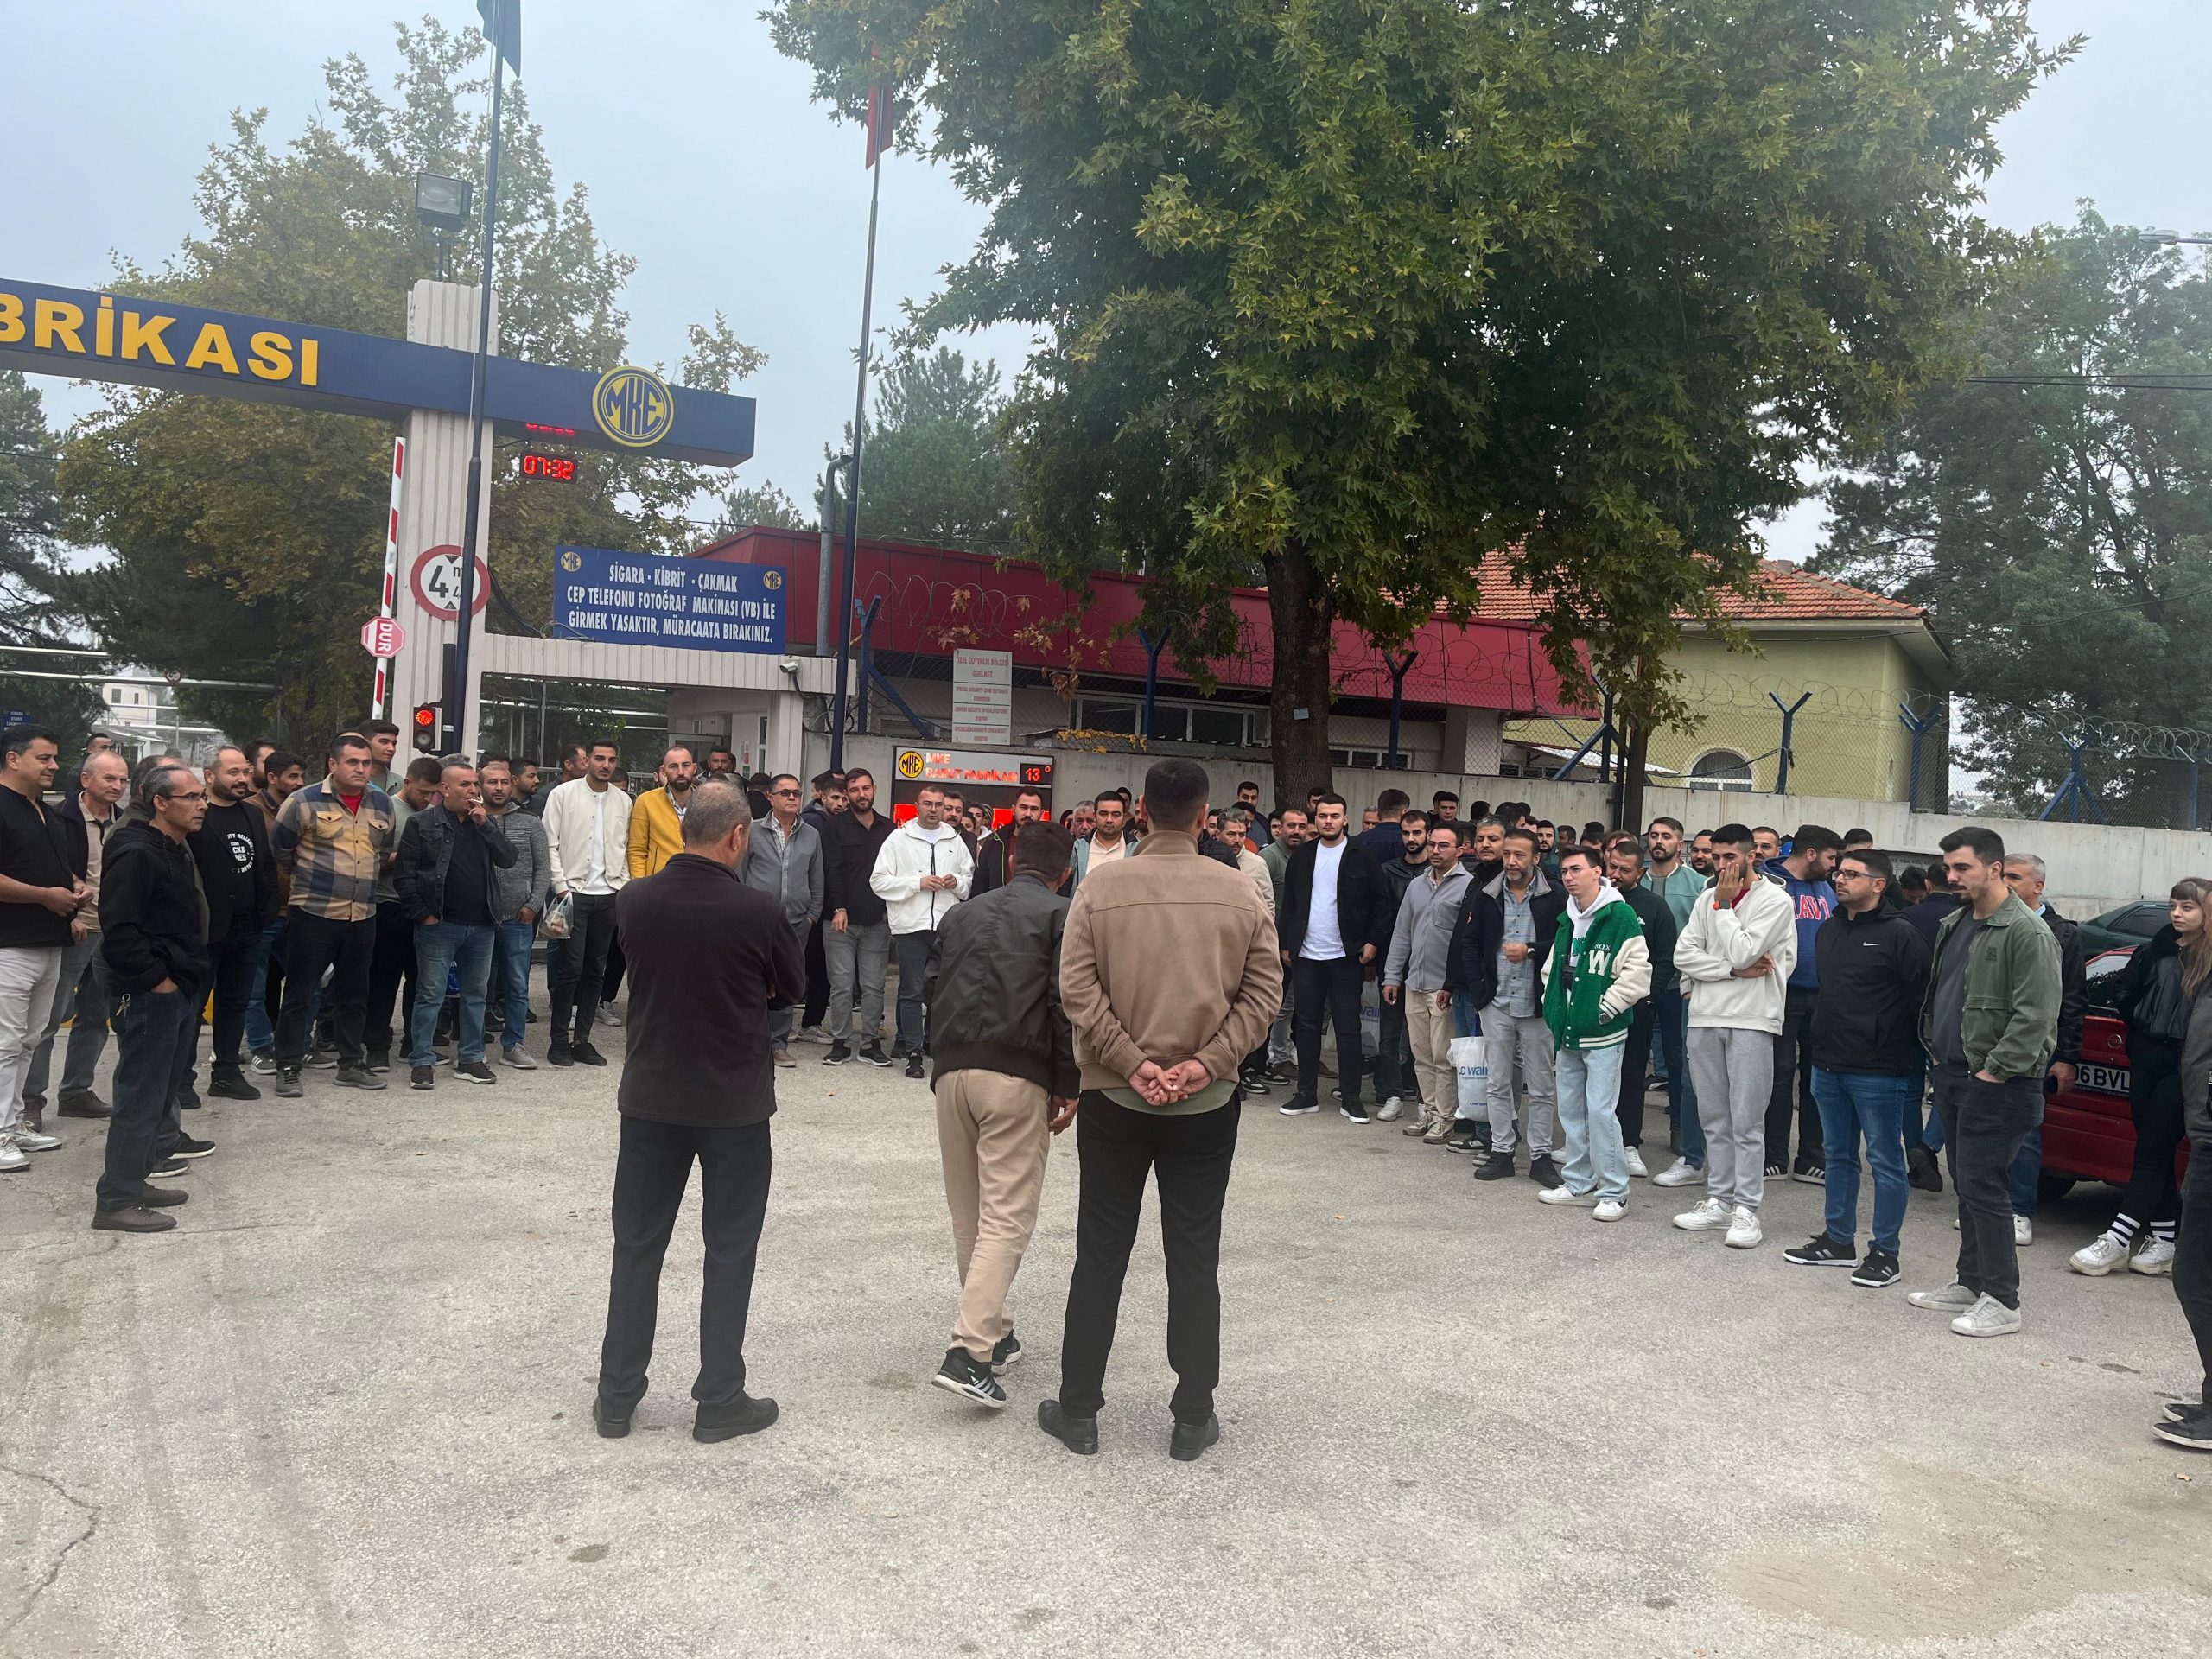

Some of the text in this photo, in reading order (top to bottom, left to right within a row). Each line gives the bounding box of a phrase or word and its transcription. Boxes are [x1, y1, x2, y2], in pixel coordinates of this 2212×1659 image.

[604, 375, 664, 437] MKE
[524, 455, 575, 480] 07:32
[561, 552, 582, 571] MKE
[429, 565, 449, 598] 4
[609, 561, 645, 584] SİGARA
[654, 566, 686, 588] KİBRİT
[698, 573, 738, 594] ÇAKMAK
[764, 571, 782, 589] MKE
[567, 586, 775, 620] CEP TELEFONU FOTOĞRAF MAKİNASI (VB) İLE
[378, 622, 393, 652] DUR
[569, 607, 773, 643] GİRMEK YASAKTIR, MÜRACAATA BIRAKINIZ.
[900, 753, 922, 775] MKE
[925, 753, 951, 765] MKE
[1588, 950, 1611, 976] W
[2094, 1068, 2130, 1090] BVL
